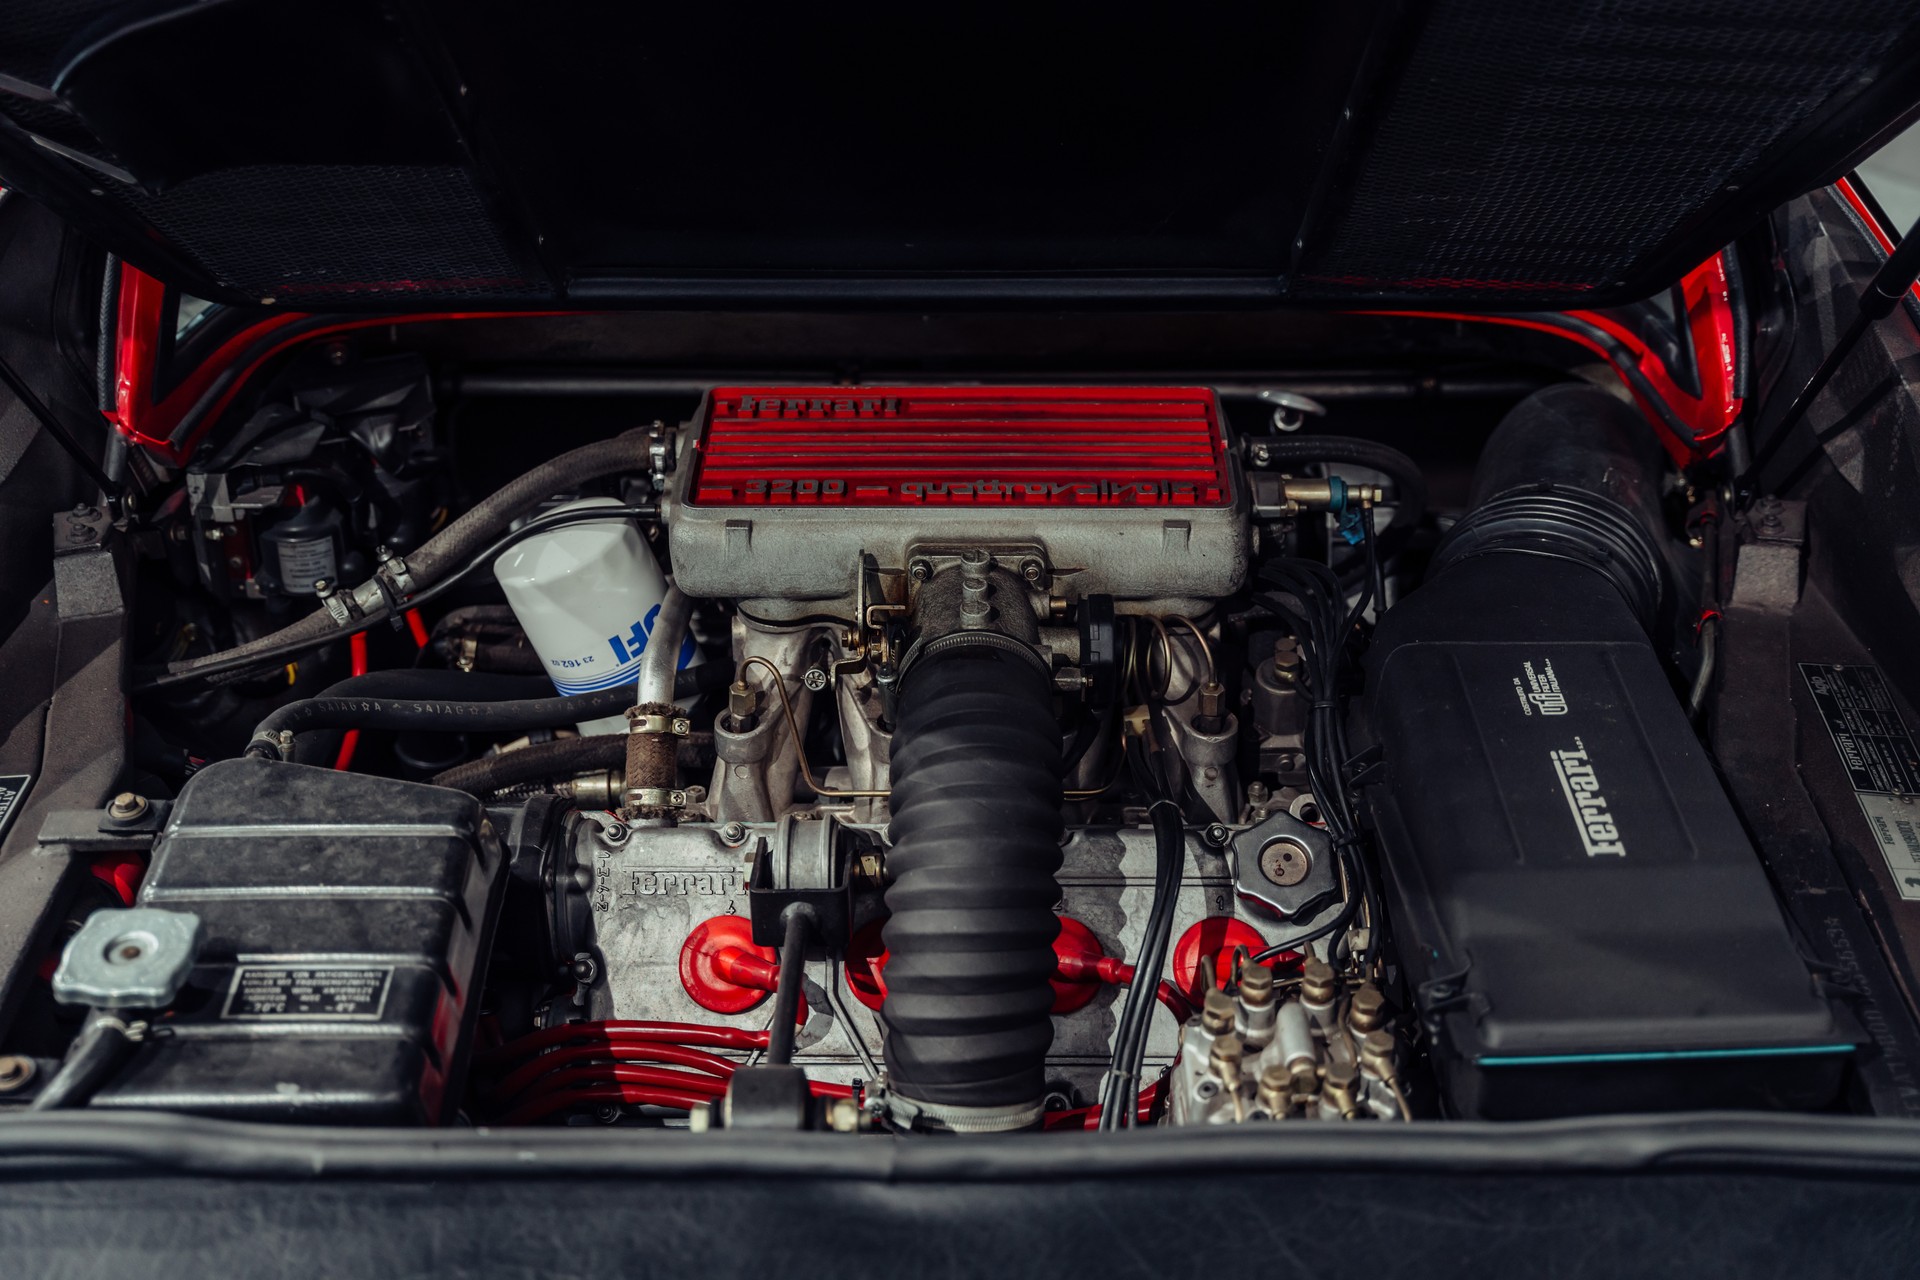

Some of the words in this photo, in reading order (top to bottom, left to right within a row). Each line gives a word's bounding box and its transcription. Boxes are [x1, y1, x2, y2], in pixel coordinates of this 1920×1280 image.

[737, 395, 898, 417] Ferrari
[744, 478, 846, 500] 3200
[561, 658, 581, 668] 162
[1523, 661, 1541, 693] UNIVERSAL
[1537, 674, 1552, 693] FILTER
[1810, 676, 1829, 695] Agip
[1835, 732, 1865, 771] Ferrari
[1550, 749, 1627, 857] Ferrari
[1873, 815, 1896, 846] Ferrari
[621, 865, 747, 896] Ferrari
